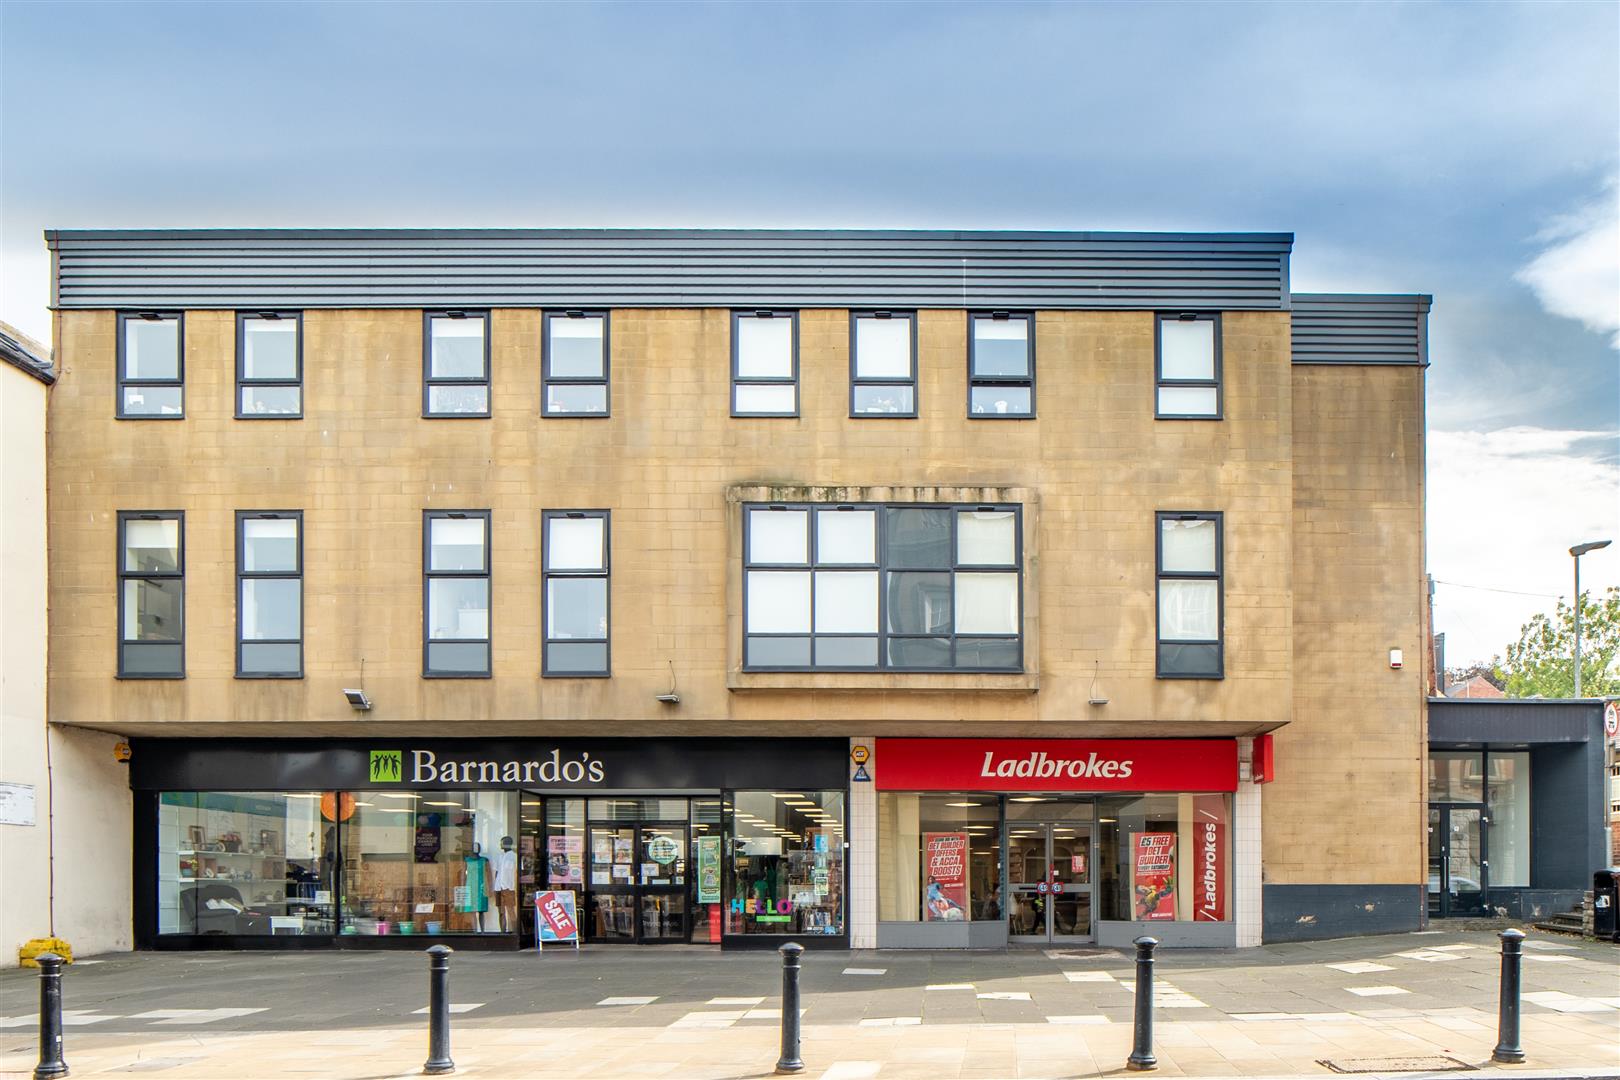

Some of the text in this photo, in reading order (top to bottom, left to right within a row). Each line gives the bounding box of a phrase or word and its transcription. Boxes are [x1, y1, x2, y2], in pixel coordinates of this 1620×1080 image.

[411, 749, 604, 782] Barnardo's
[981, 751, 1133, 778] Ladbrokes
[940, 841, 964, 849] BUILDER
[1141, 837, 1169, 846] £5 FREE
[936, 849, 957, 857] OFFERS
[1147, 847, 1161, 855] BET
[932, 857, 959, 866] & ACCA
[1139, 856, 1169, 865] BUILDER
[933, 866, 961, 875] BOOSTS
[1204, 823, 1217, 911] Ladbrokes
[731, 899, 793, 914] HELLO
[544, 900, 572, 930] SALE
